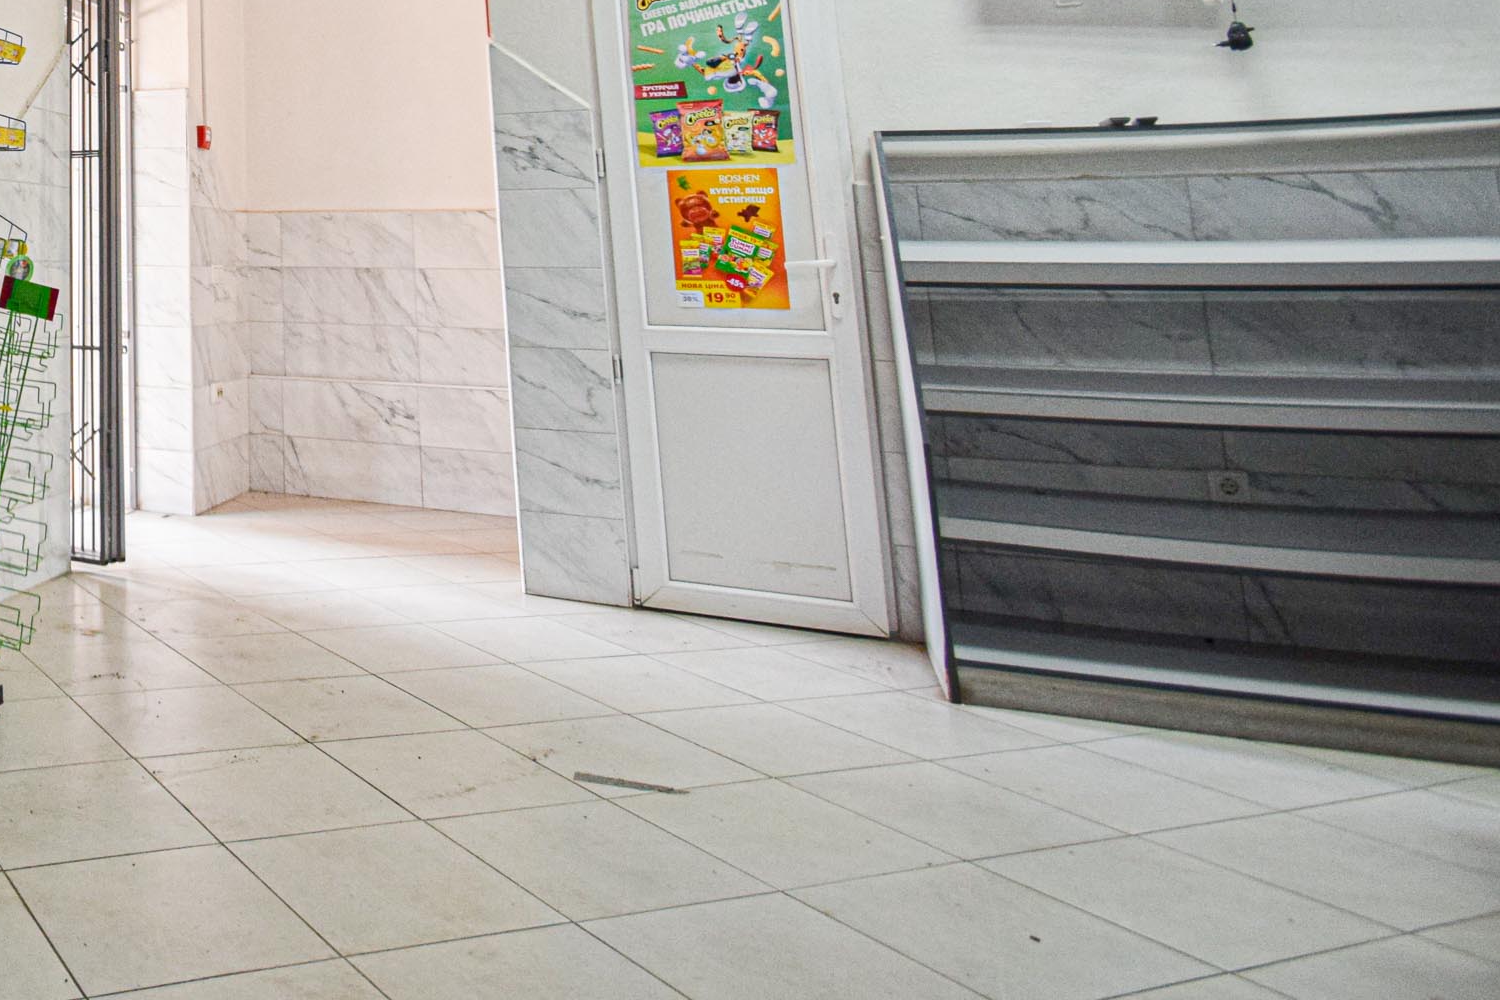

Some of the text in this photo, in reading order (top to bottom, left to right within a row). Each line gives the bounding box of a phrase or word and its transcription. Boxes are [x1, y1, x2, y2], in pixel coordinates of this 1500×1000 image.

[639, 21, 666, 37] ГРА
[718, 174, 760, 183] ROSHEN
[706, 292, 724, 303] 19
